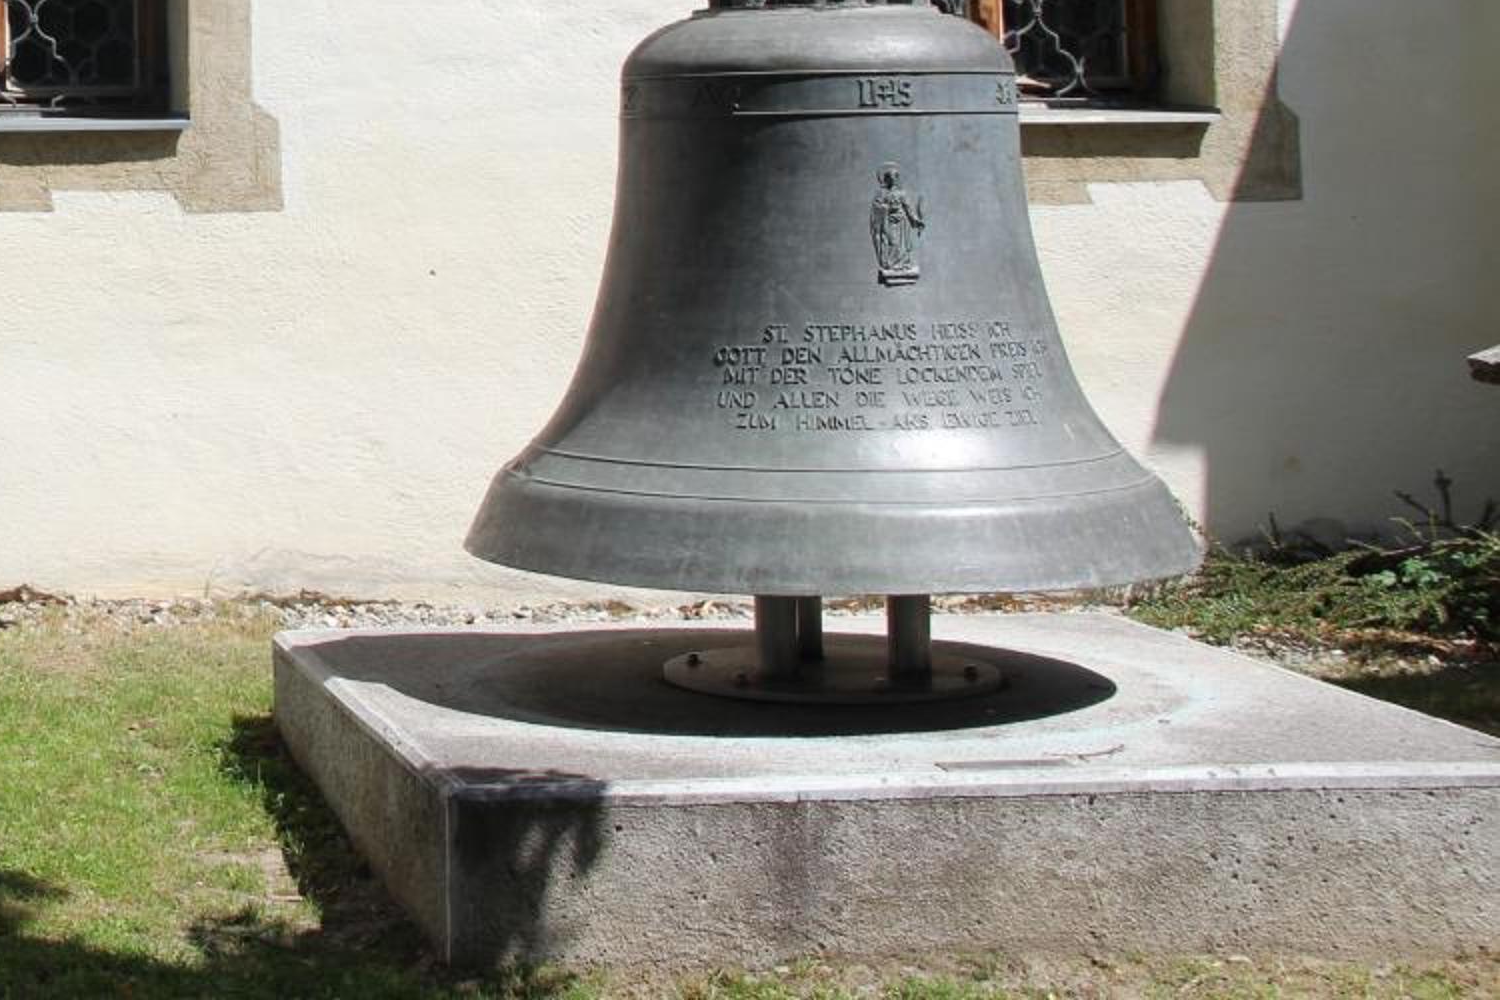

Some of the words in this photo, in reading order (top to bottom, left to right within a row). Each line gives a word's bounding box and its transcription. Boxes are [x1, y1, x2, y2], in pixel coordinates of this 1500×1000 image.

[803, 323, 917, 342] STEPHANUS
[712, 347, 767, 368] GOTT
[781, 347, 821, 366] DEN
[723, 367, 760, 386] MIT
[770, 367, 808, 385] DER
[717, 391, 757, 409] UND
[773, 390, 839, 409] ALLEN
[854, 390, 886, 408] DIE
[736, 412, 776, 431] ZUM
[795, 414, 875, 431] HIMMEL
